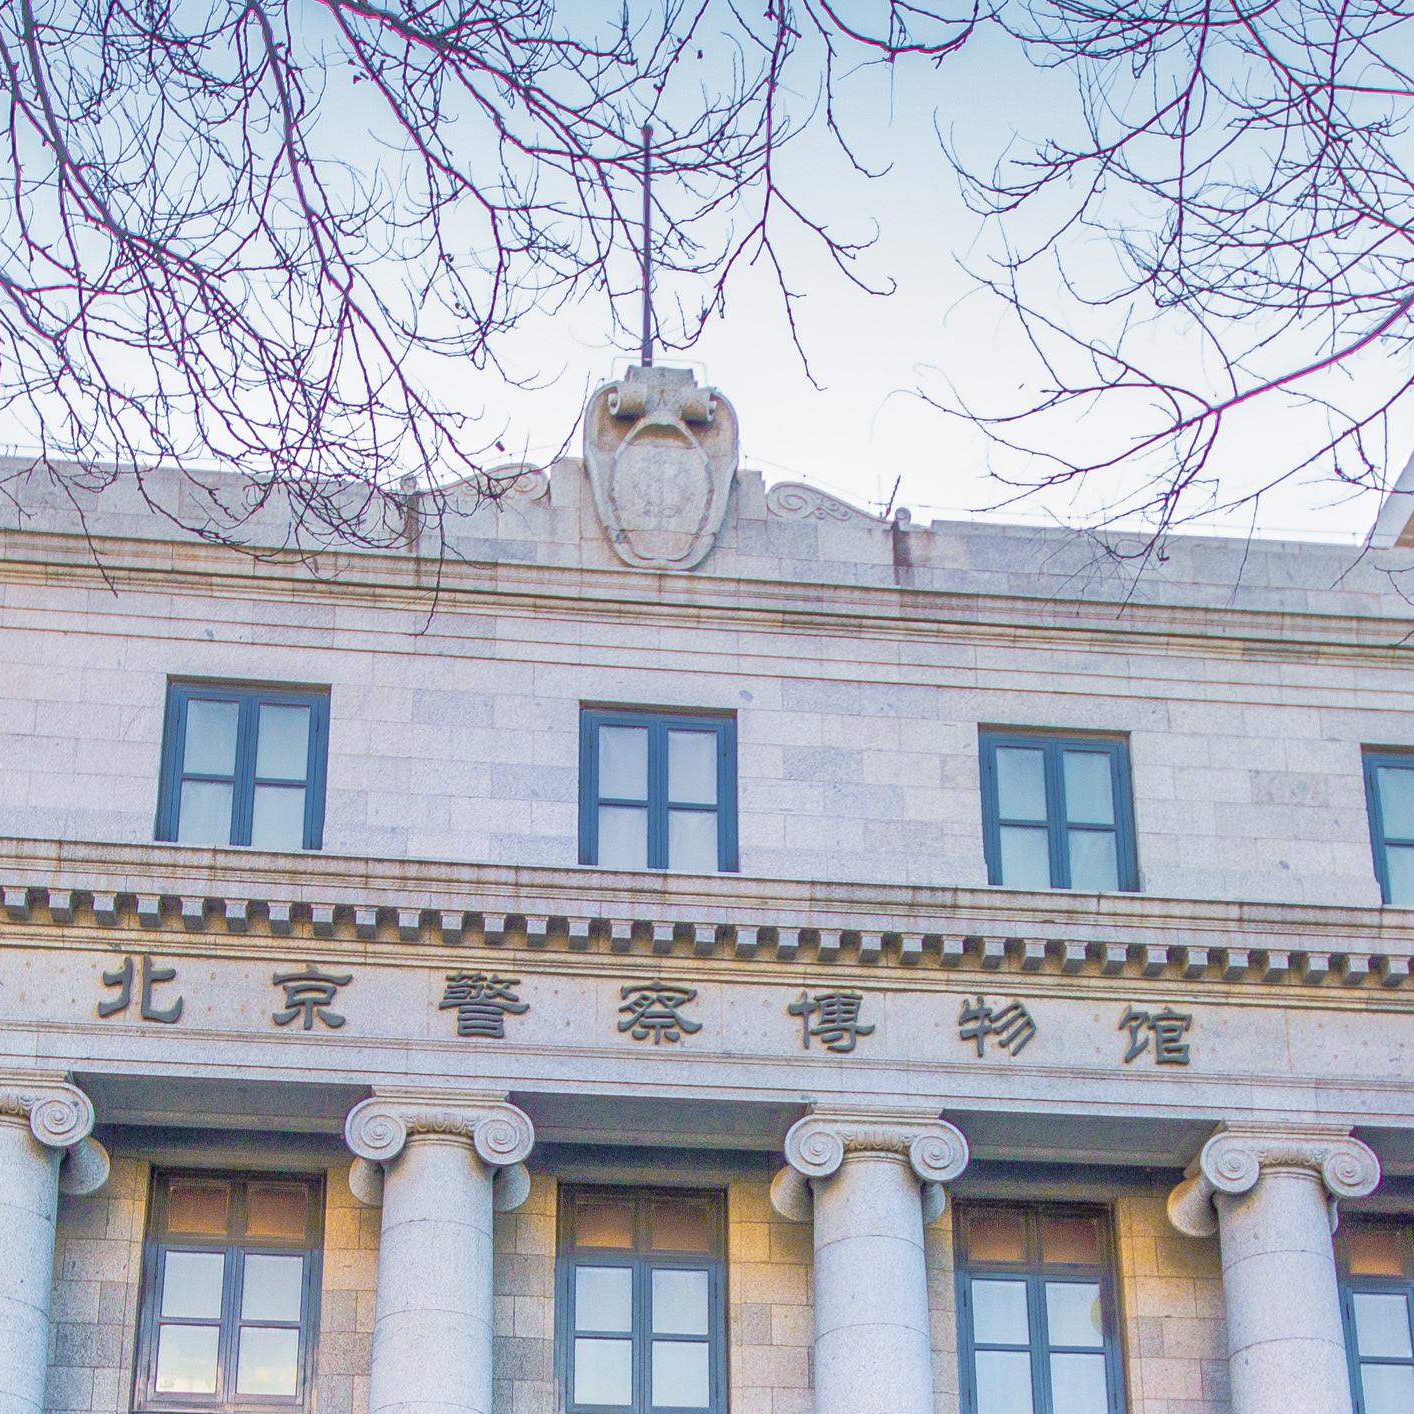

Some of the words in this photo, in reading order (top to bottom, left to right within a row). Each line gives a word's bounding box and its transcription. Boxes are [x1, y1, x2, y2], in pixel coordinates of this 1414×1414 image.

[96, 956, 1195, 1067] 北京警察博物馆
